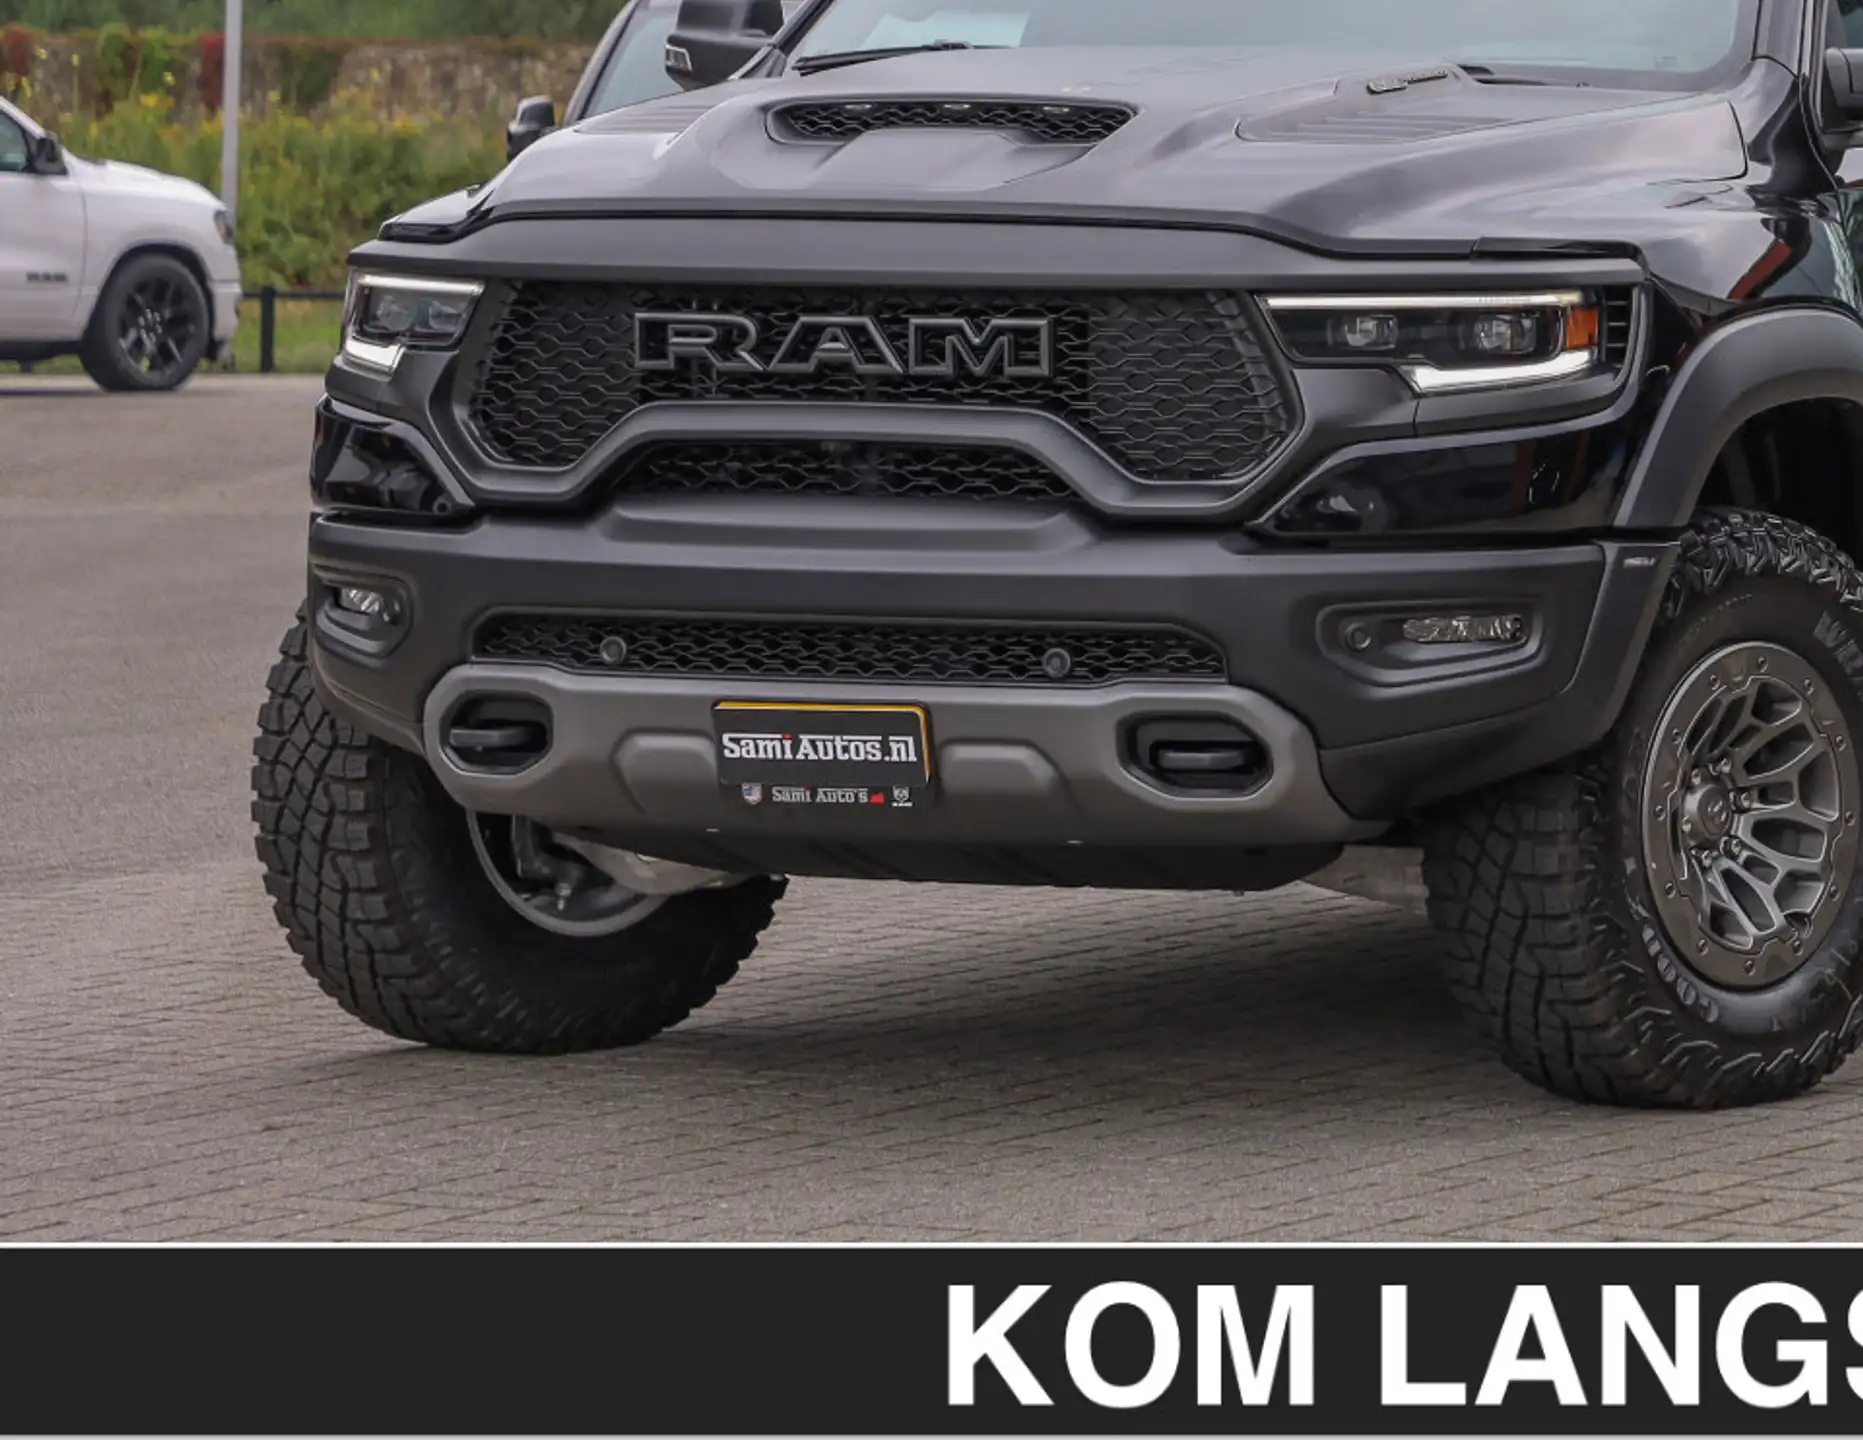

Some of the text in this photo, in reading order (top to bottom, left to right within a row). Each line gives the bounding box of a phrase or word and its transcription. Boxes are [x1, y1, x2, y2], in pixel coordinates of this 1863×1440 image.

[634, 311, 1054, 378] RAM
[771, 785, 869, 803] Sami Auto's
